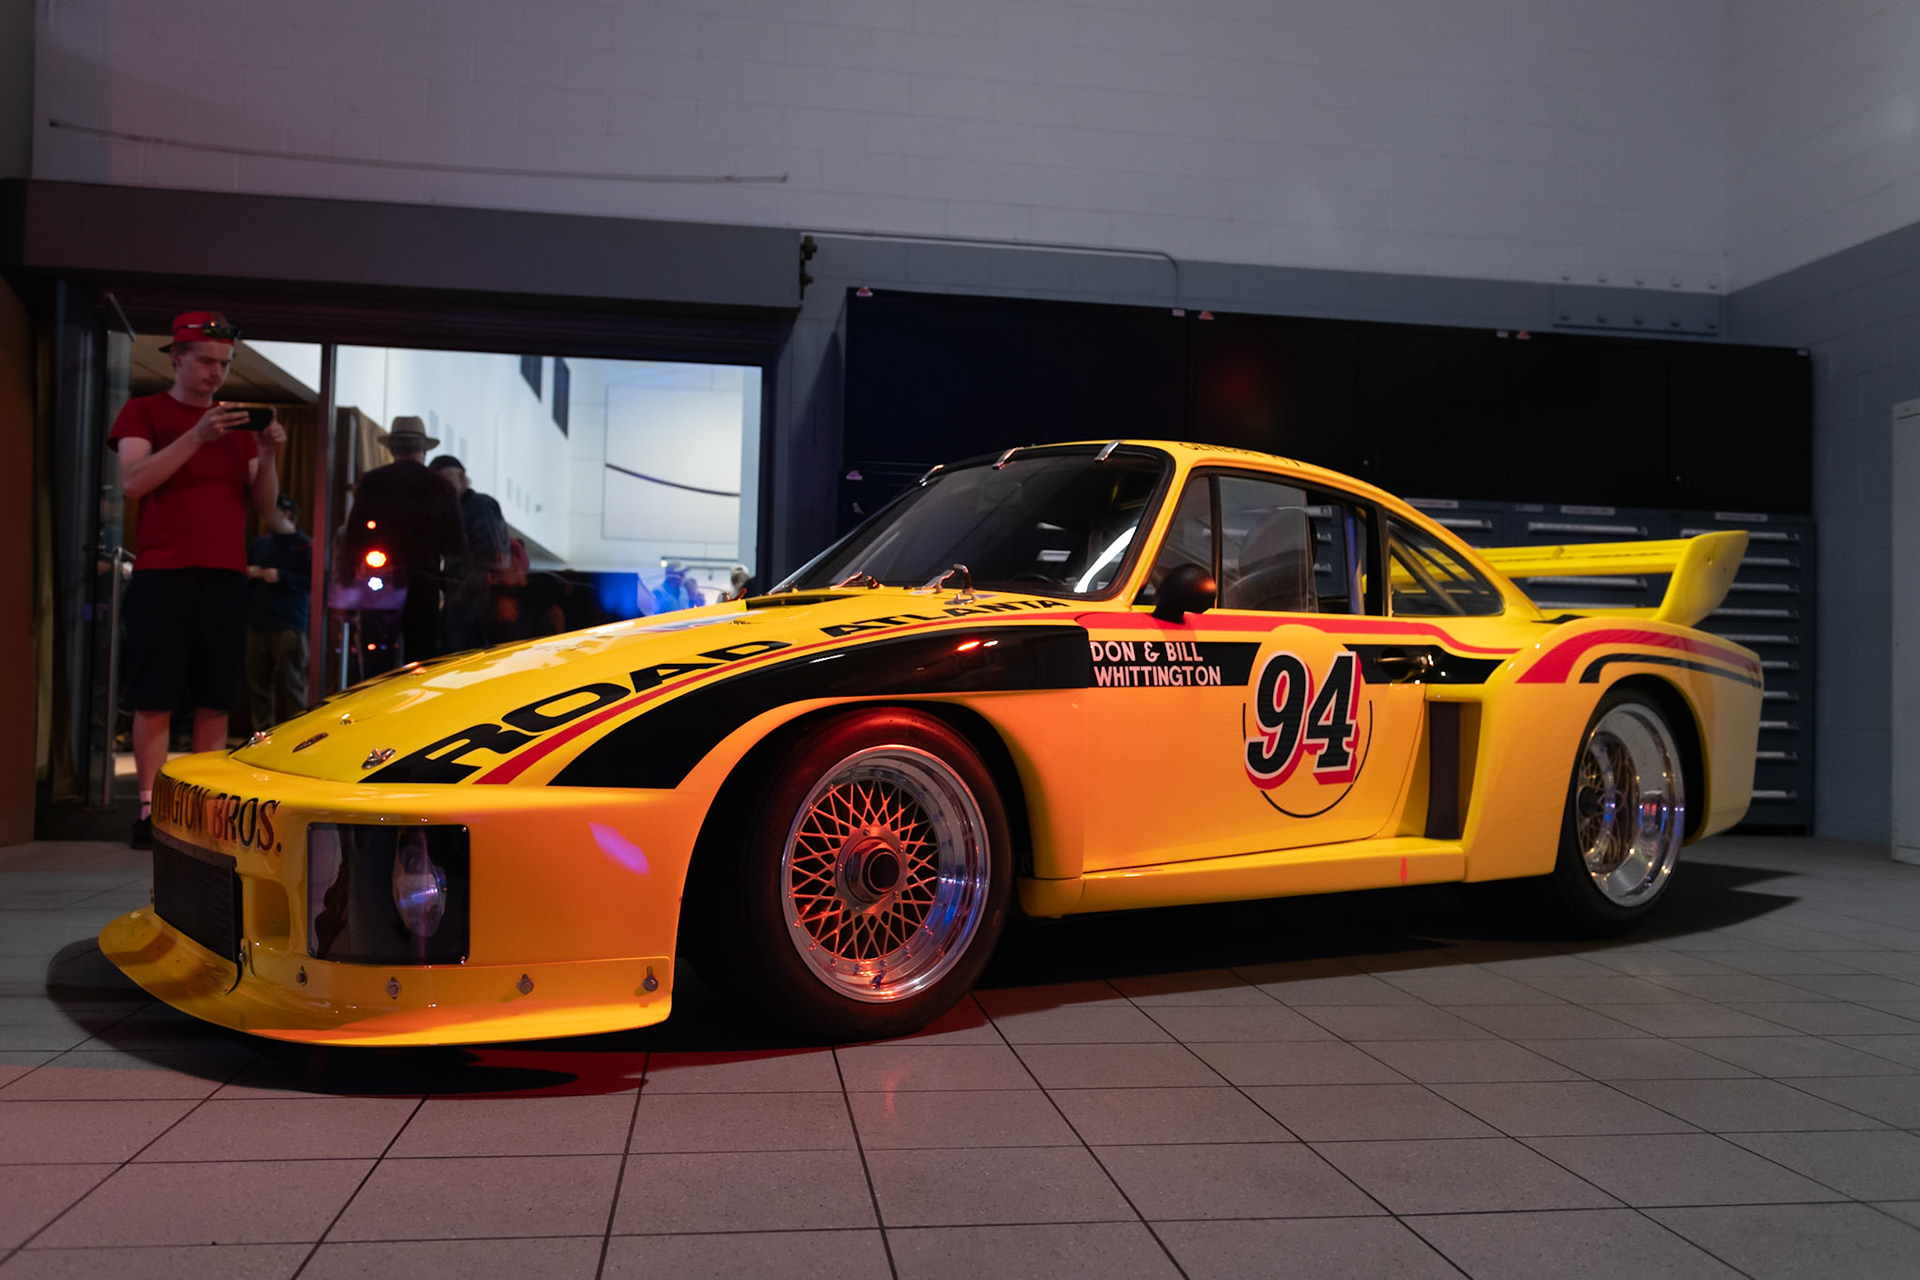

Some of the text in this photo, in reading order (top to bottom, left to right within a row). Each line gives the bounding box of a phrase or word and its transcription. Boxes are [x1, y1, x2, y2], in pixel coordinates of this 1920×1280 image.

[1089, 641, 1204, 663] DON & BILL
[1093, 665, 1221, 687] WHITTINGTON
[358, 599, 1071, 784] ROAD ATLANTA
[1244, 650, 1362, 789] 94
[211, 792, 282, 852] BROS.
